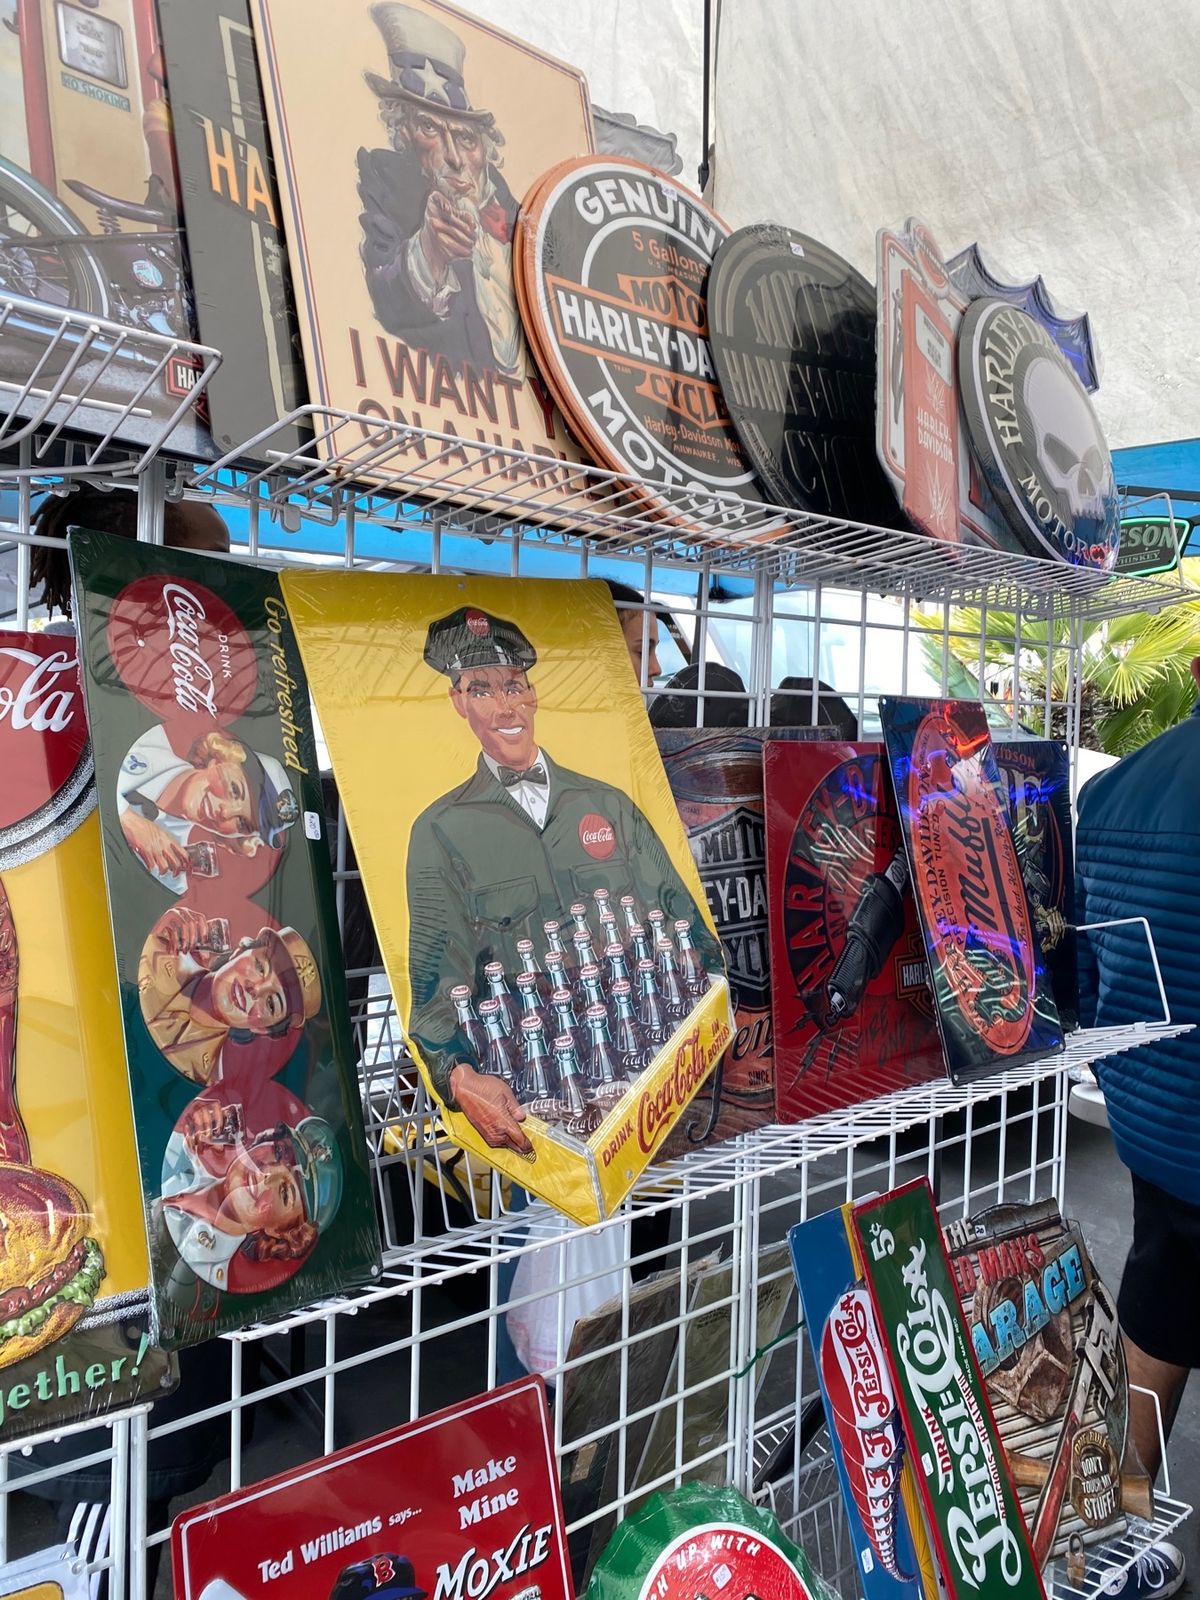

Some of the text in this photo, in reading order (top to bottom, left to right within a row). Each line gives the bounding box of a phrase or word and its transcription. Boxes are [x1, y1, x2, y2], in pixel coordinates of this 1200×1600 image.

[574, 178, 724, 255] GENUIN
[631, 230, 708, 278] 5 Gallons
[629, 279, 706, 329] MOTO
[556, 289, 716, 380] HARLEY-DA
[348, 327, 367, 388] I
[376, 335, 523, 431] WANT
[357, 398, 428, 461] ON
[439, 419, 472, 472] A
[218, 633, 232, 679] DRINK
[263, 595, 309, 777] Go refreshed
[712, 1017, 720, 1038] IN
[601, 1119, 634, 1168] DRINK
[977, 1232, 1045, 1287] MAN'S
[971, 1243, 1088, 1379] ARAGE
[0, 1331, 150, 1426] ether!
[921, 1406, 953, 1474] DRINK
[1081, 1456, 1103, 1478] DON'T
[451, 1454, 518, 1499] Make
[1083, 1487, 1117, 1521] STUFF!
[458, 1487, 519, 1530] Mine
[258, 1505, 423, 1584] Ted Williams says...
[433, 1523, 552, 1600] MOXIE
[676, 1543, 698, 1571] UP
[710, 1533, 761, 1558] WITH
